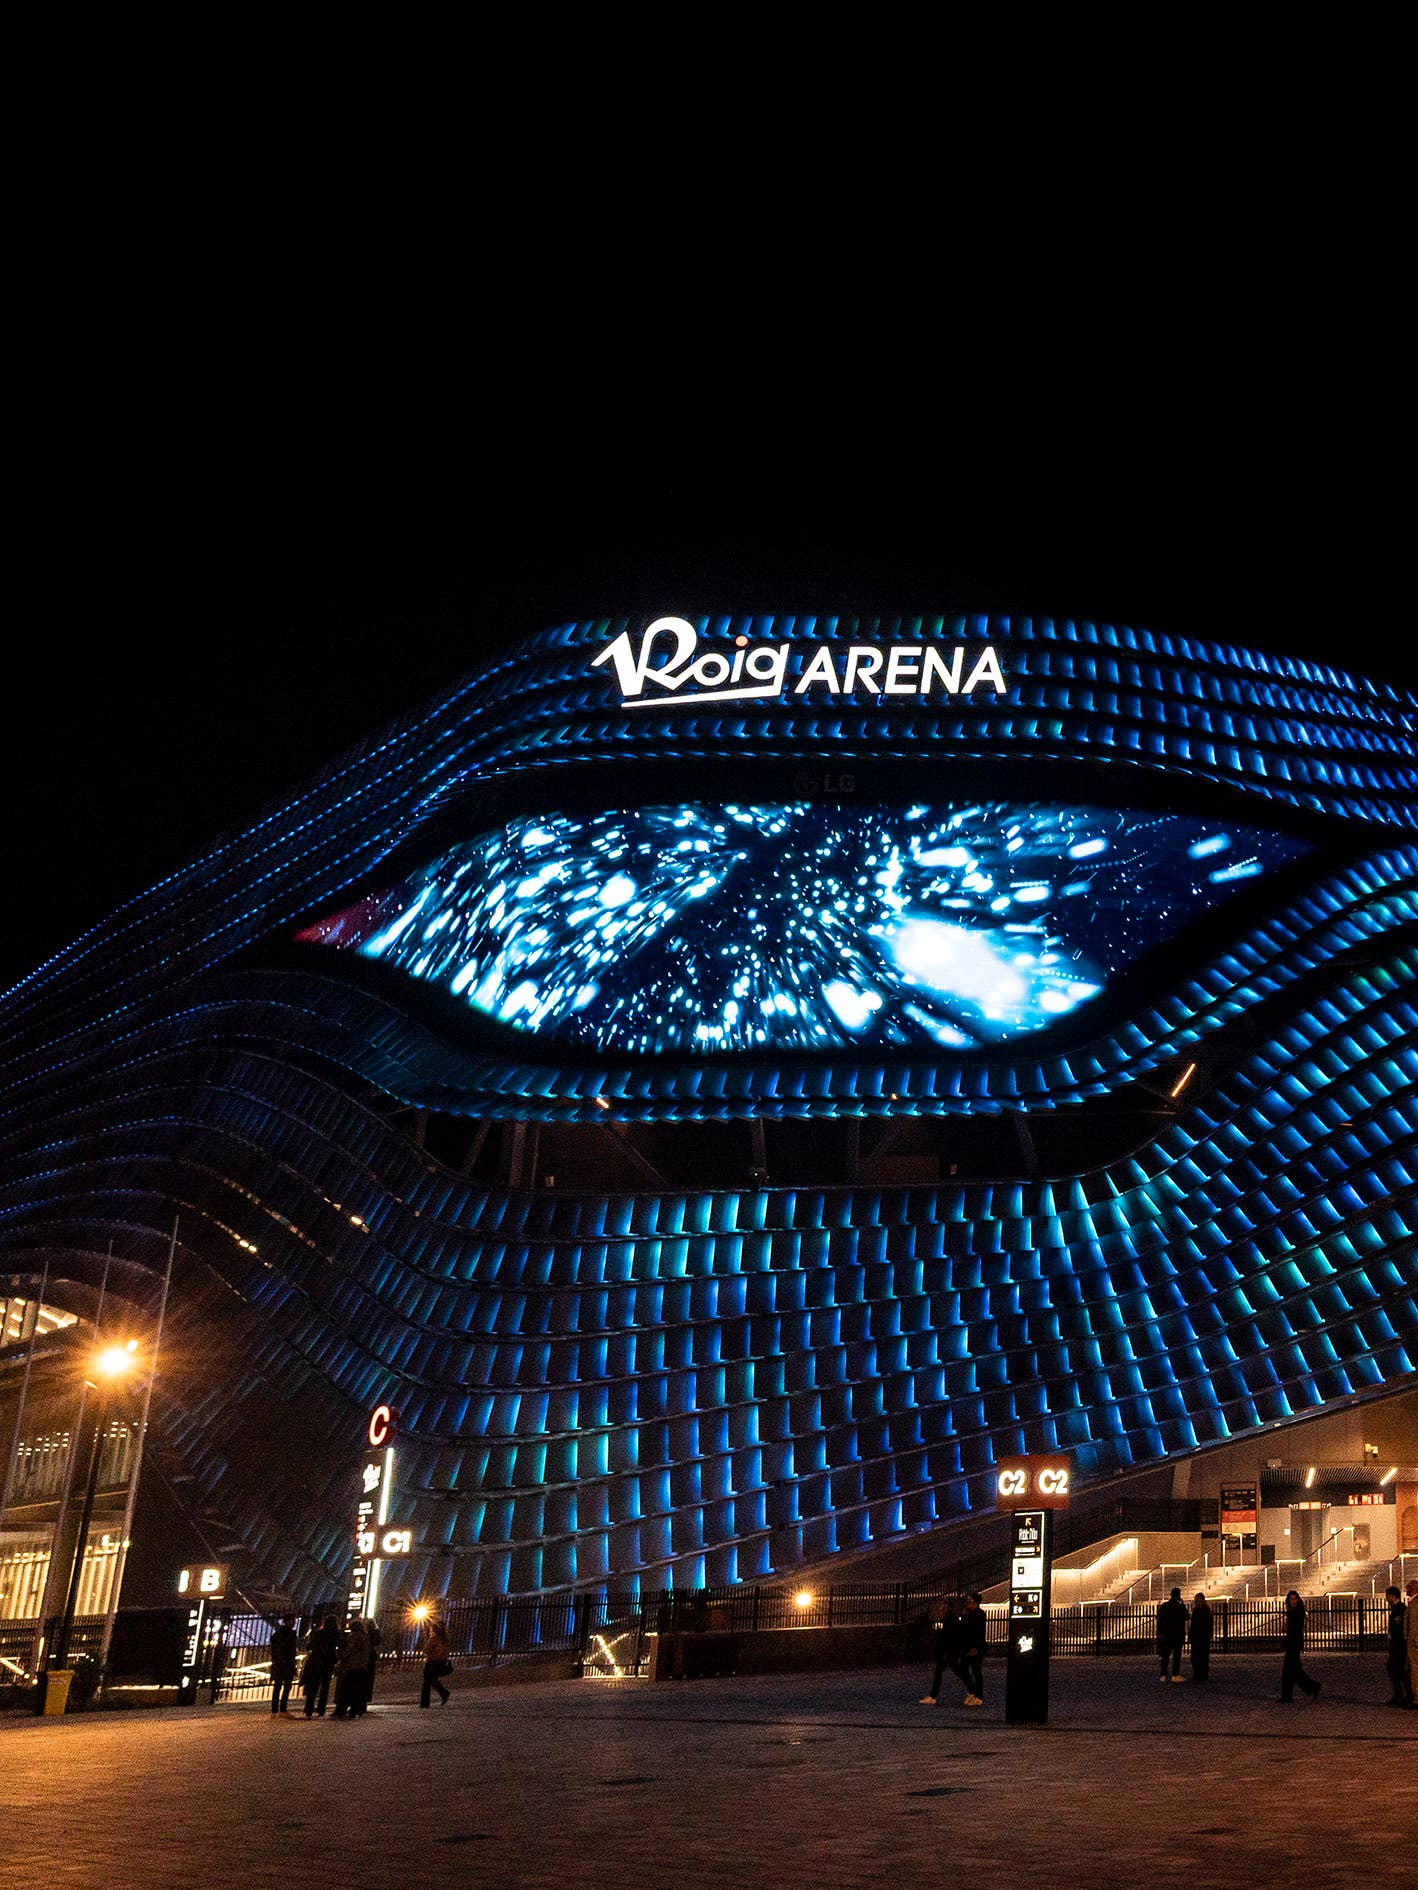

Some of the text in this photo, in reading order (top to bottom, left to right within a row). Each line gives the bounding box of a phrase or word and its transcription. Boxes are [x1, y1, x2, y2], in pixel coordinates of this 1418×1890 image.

[591, 616, 1007, 708] Roig ARENA
[368, 1405, 390, 1445] C
[998, 1469, 1068, 1496] C2 C2
[200, 1568, 220, 1592] B
